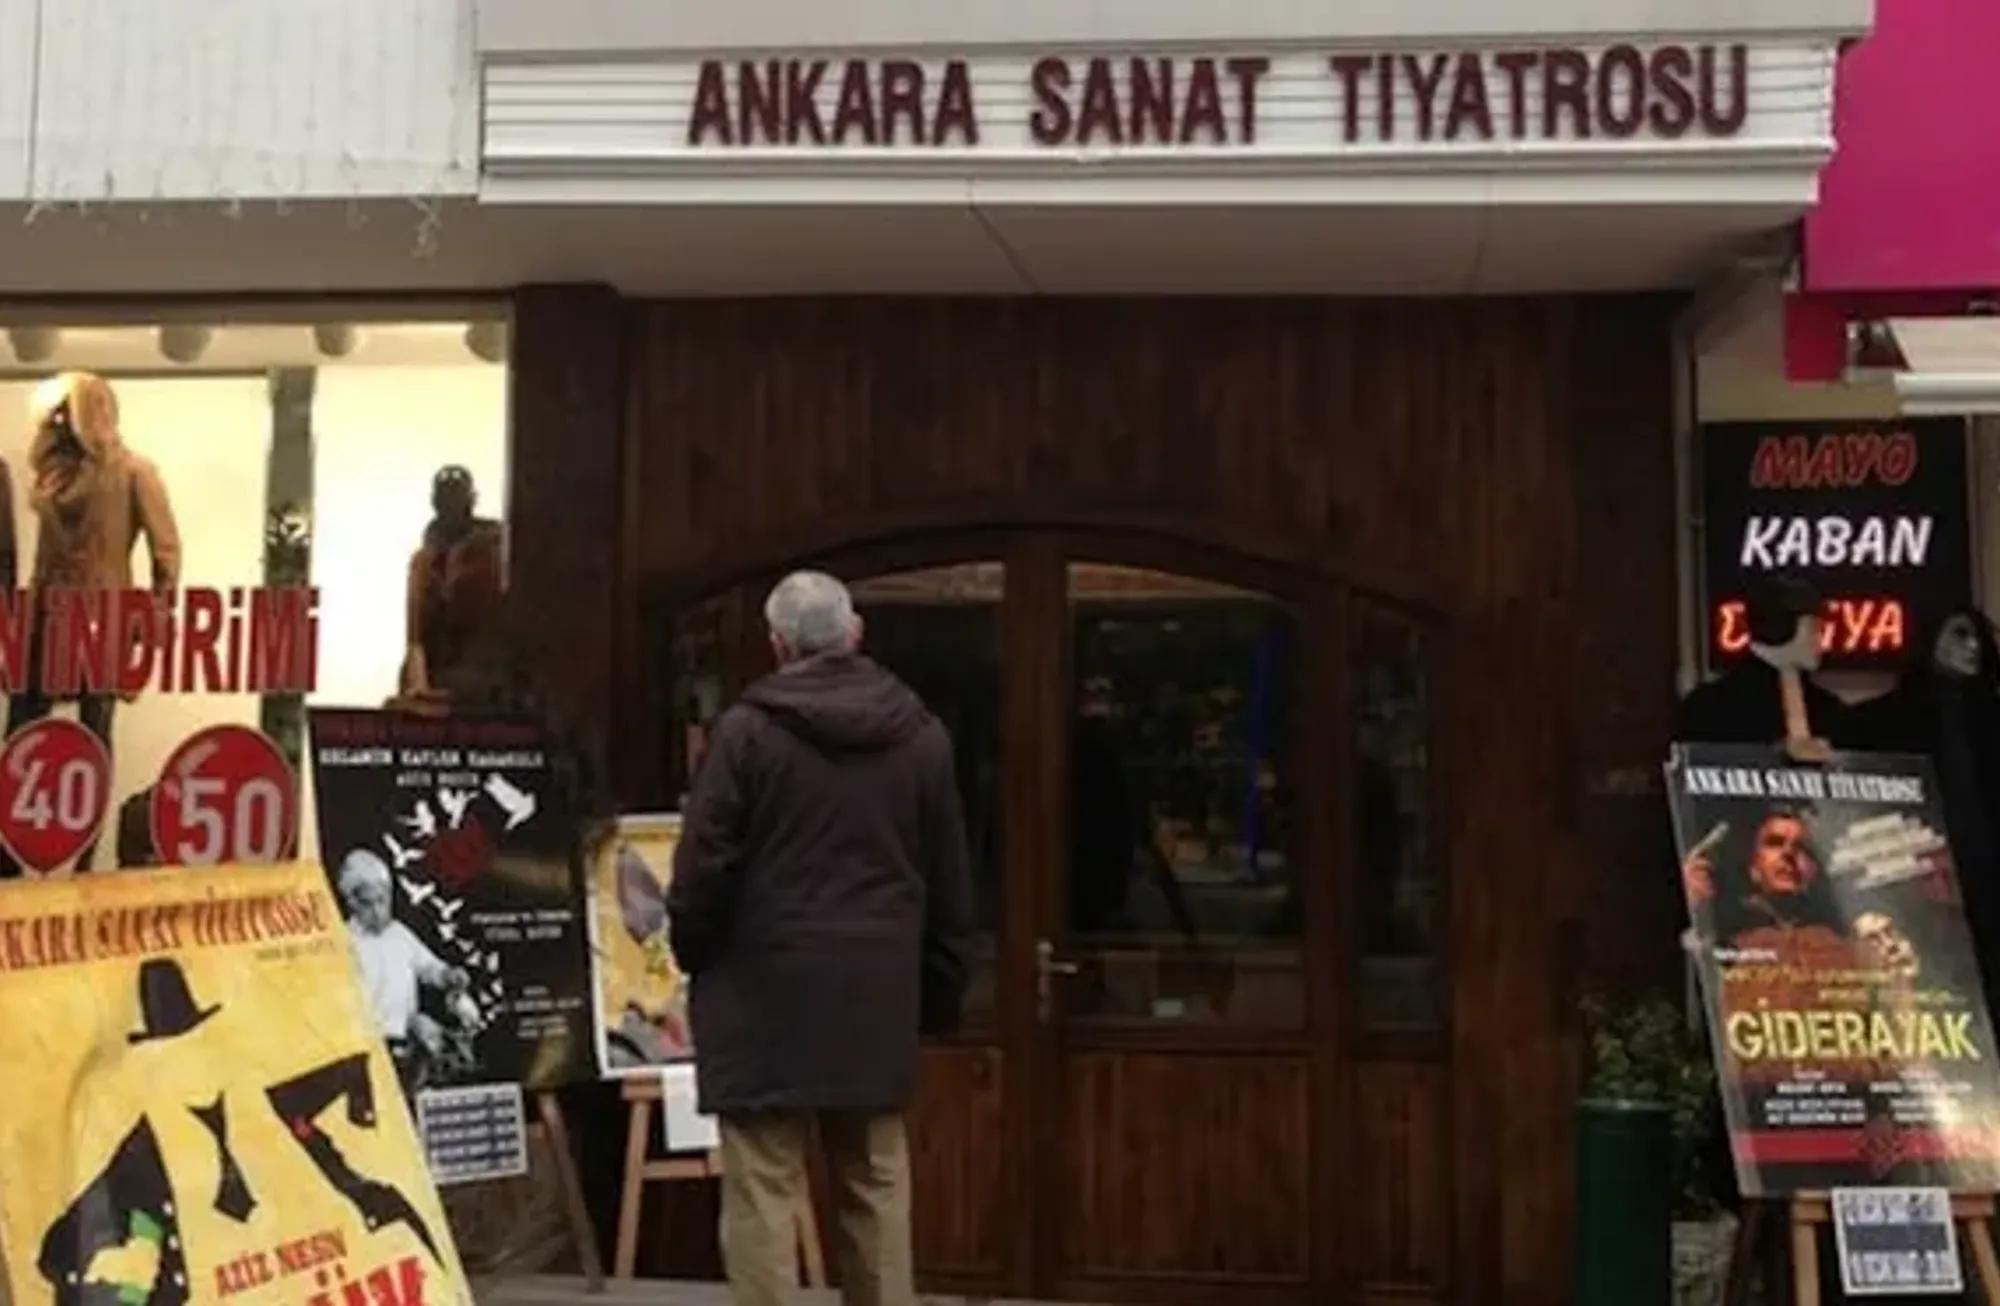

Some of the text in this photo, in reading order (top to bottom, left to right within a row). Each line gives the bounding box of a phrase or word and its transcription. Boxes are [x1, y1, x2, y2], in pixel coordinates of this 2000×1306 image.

[689, 44, 1748, 145] ANKARA SANAT TIYATROSU
[1751, 431, 1917, 489] MAYO
[1740, 515, 1933, 570] KABAN
[11, 759, 97, 831] 40
[177, 776, 284, 865] 50
[1726, 997, 1982, 1062] GİDERAYAK
